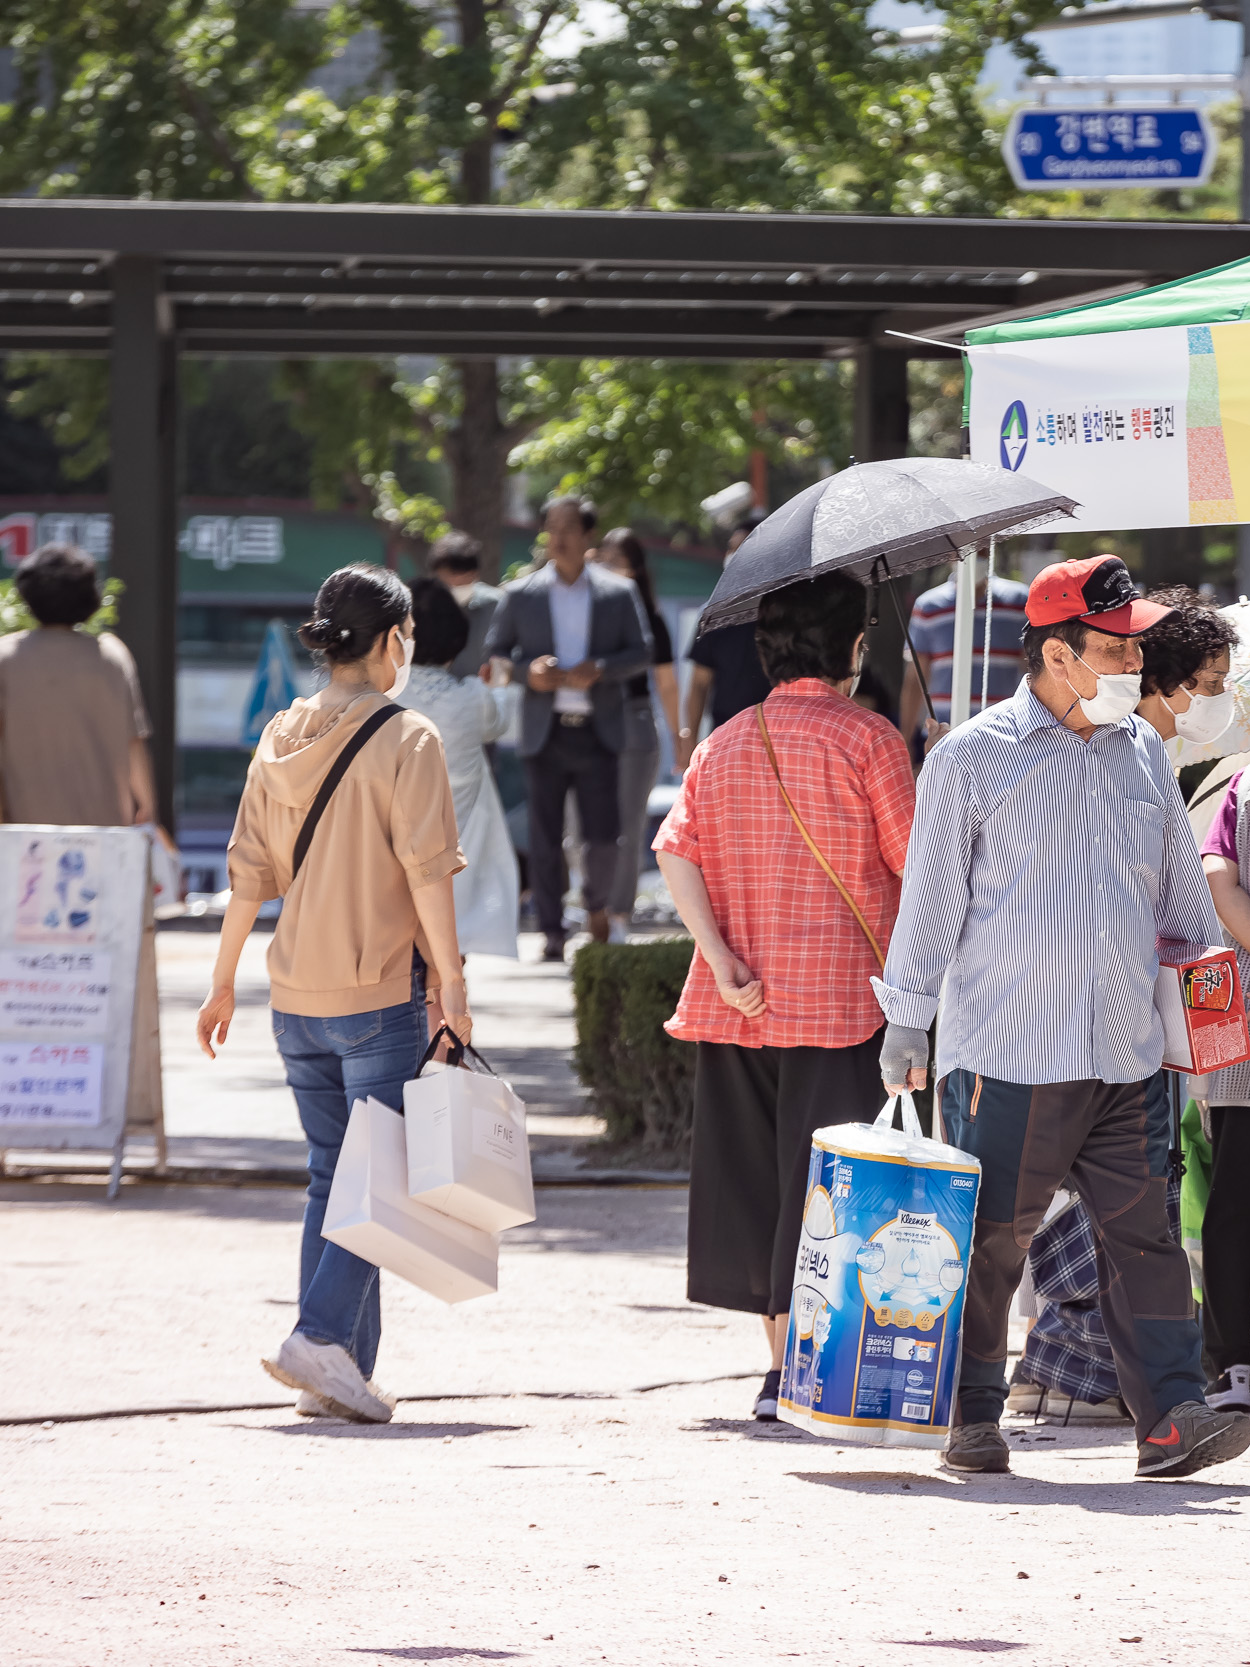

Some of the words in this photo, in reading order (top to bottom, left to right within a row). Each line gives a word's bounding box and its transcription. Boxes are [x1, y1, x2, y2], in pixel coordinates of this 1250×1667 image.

[1055, 115, 1162, 153] 강변역로
[1035, 408, 1078, 446] 소통하며
[1082, 404, 1124, 443] 발전하는
[1131, 405, 1175, 440] 행복광진
[900, 1213, 931, 1227] Kleenex
